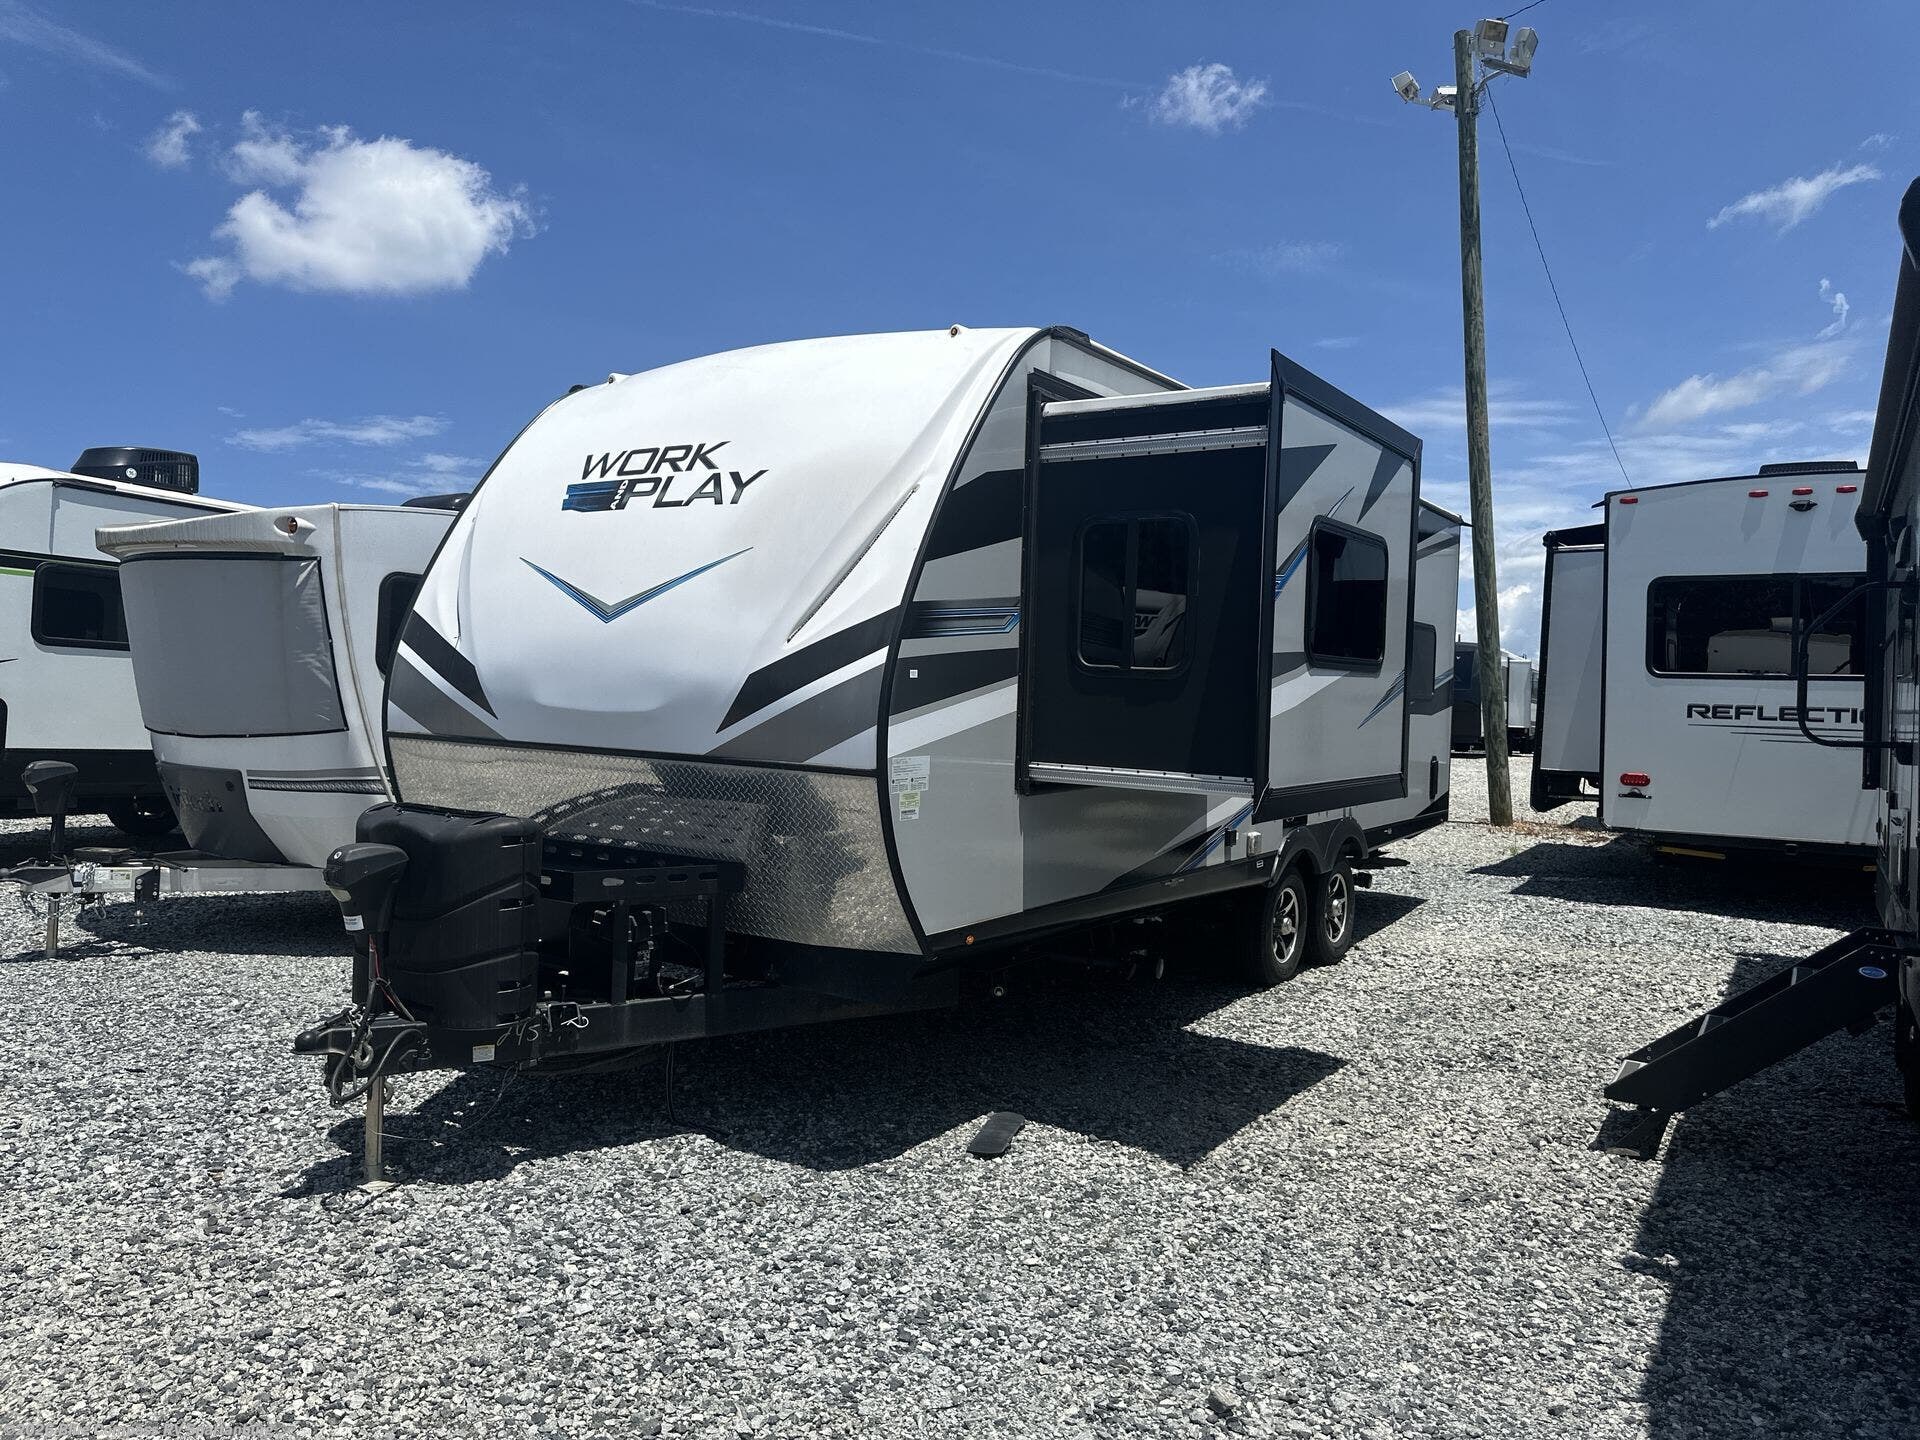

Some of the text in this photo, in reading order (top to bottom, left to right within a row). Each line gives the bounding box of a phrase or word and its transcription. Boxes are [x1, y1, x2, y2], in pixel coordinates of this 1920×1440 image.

[582, 440, 732, 480] WORK
[609, 479, 629, 511] AND
[621, 469, 770, 510] PLAY
